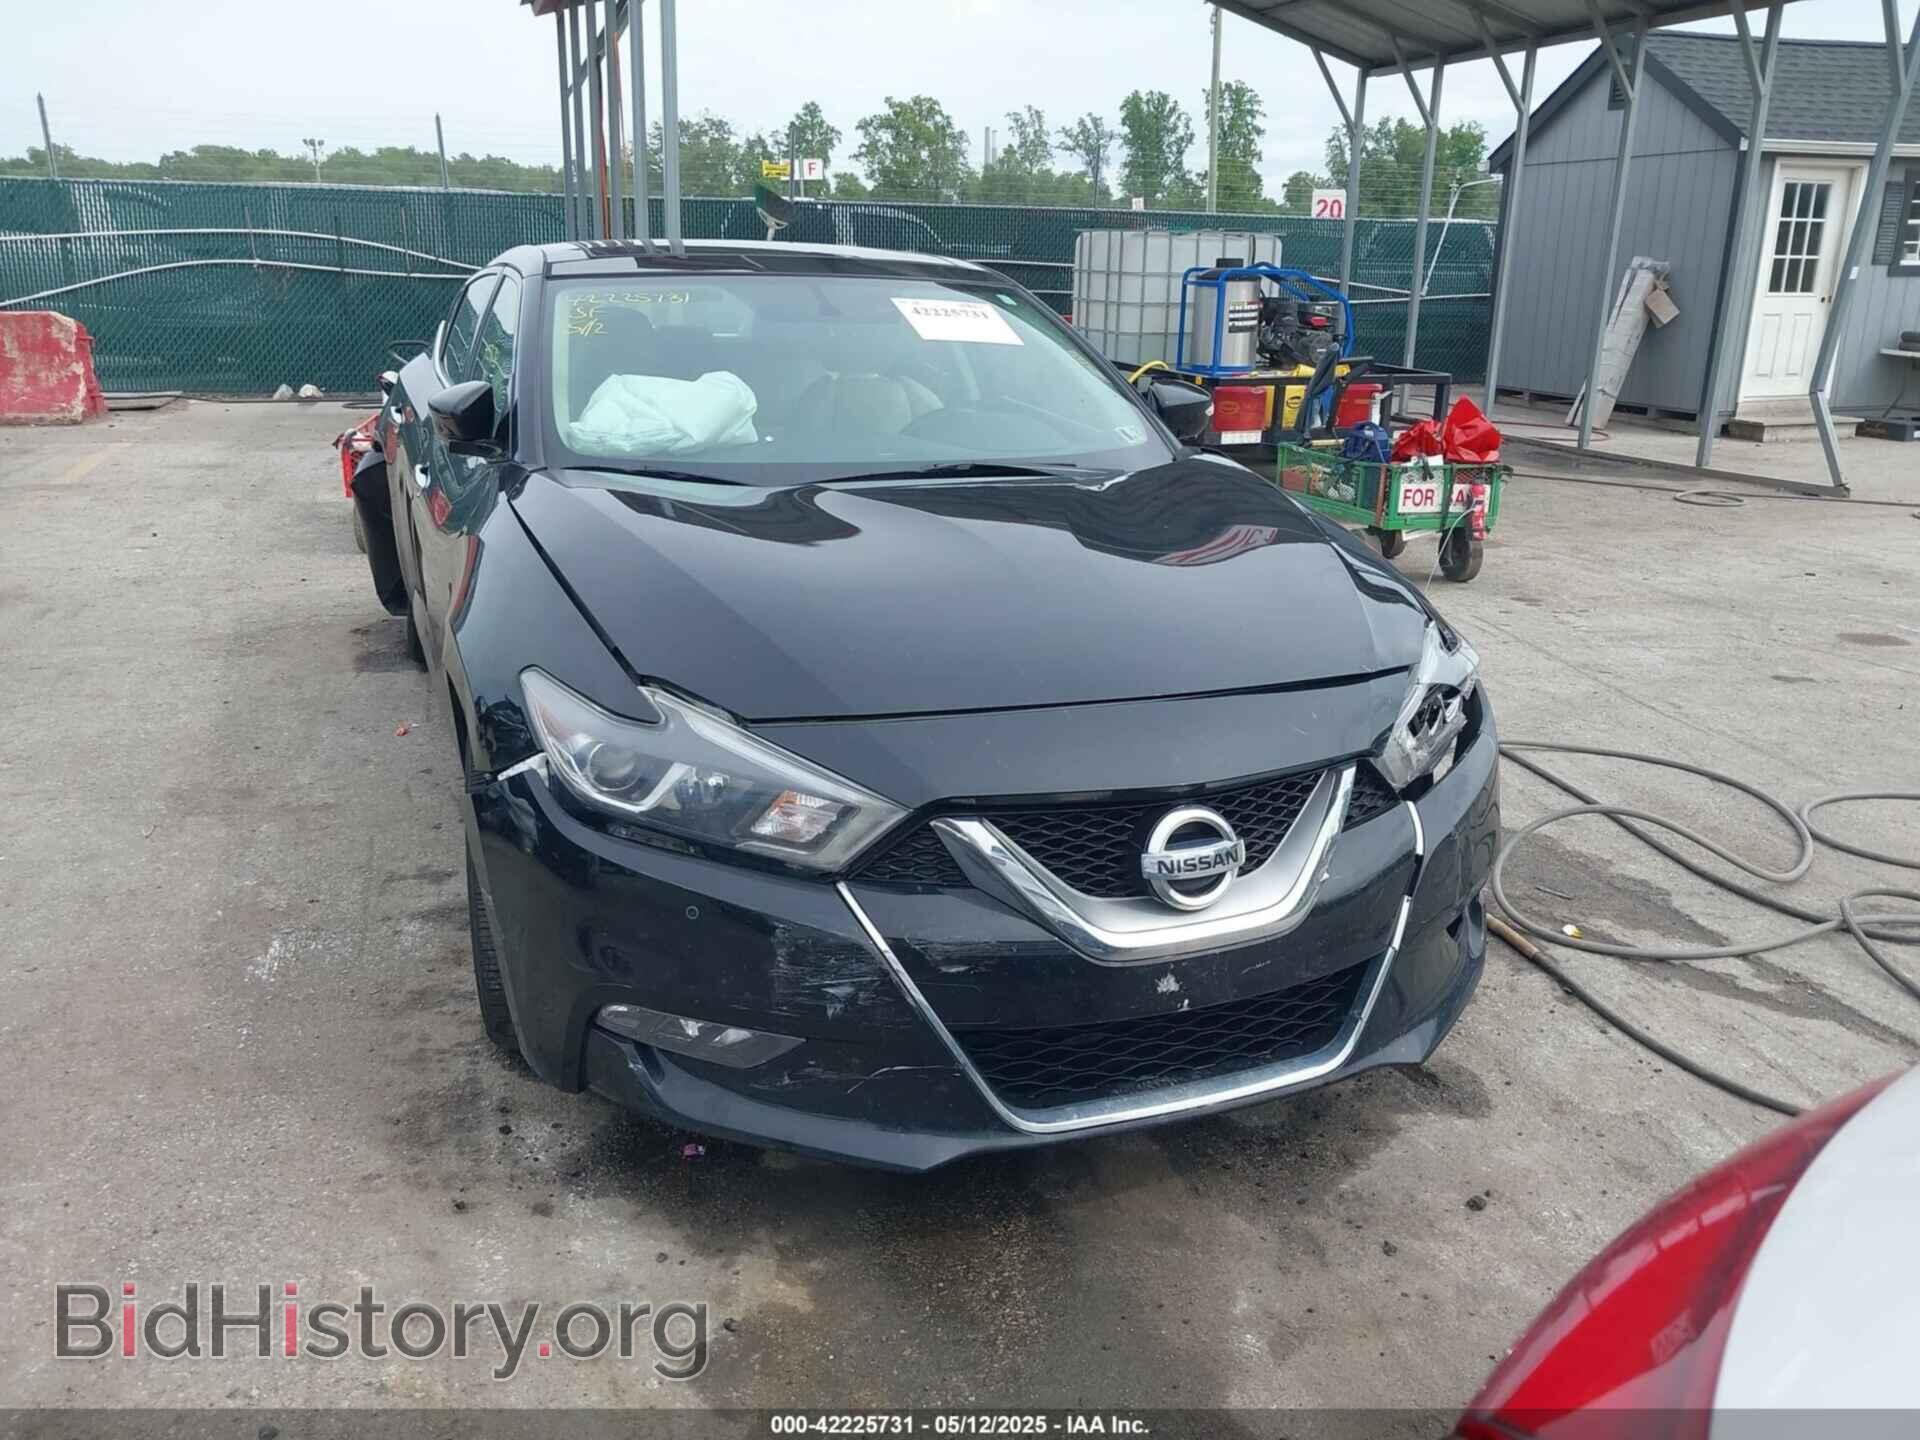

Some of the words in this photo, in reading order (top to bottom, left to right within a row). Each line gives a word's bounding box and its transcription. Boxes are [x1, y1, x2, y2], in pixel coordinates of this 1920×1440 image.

[808, 162, 816, 176] F
[1316, 199, 1342, 218] 20
[912, 306, 989, 319] 42225731
[1402, 489, 1435, 507] FOR
[1157, 846, 1239, 874] NISSAN
